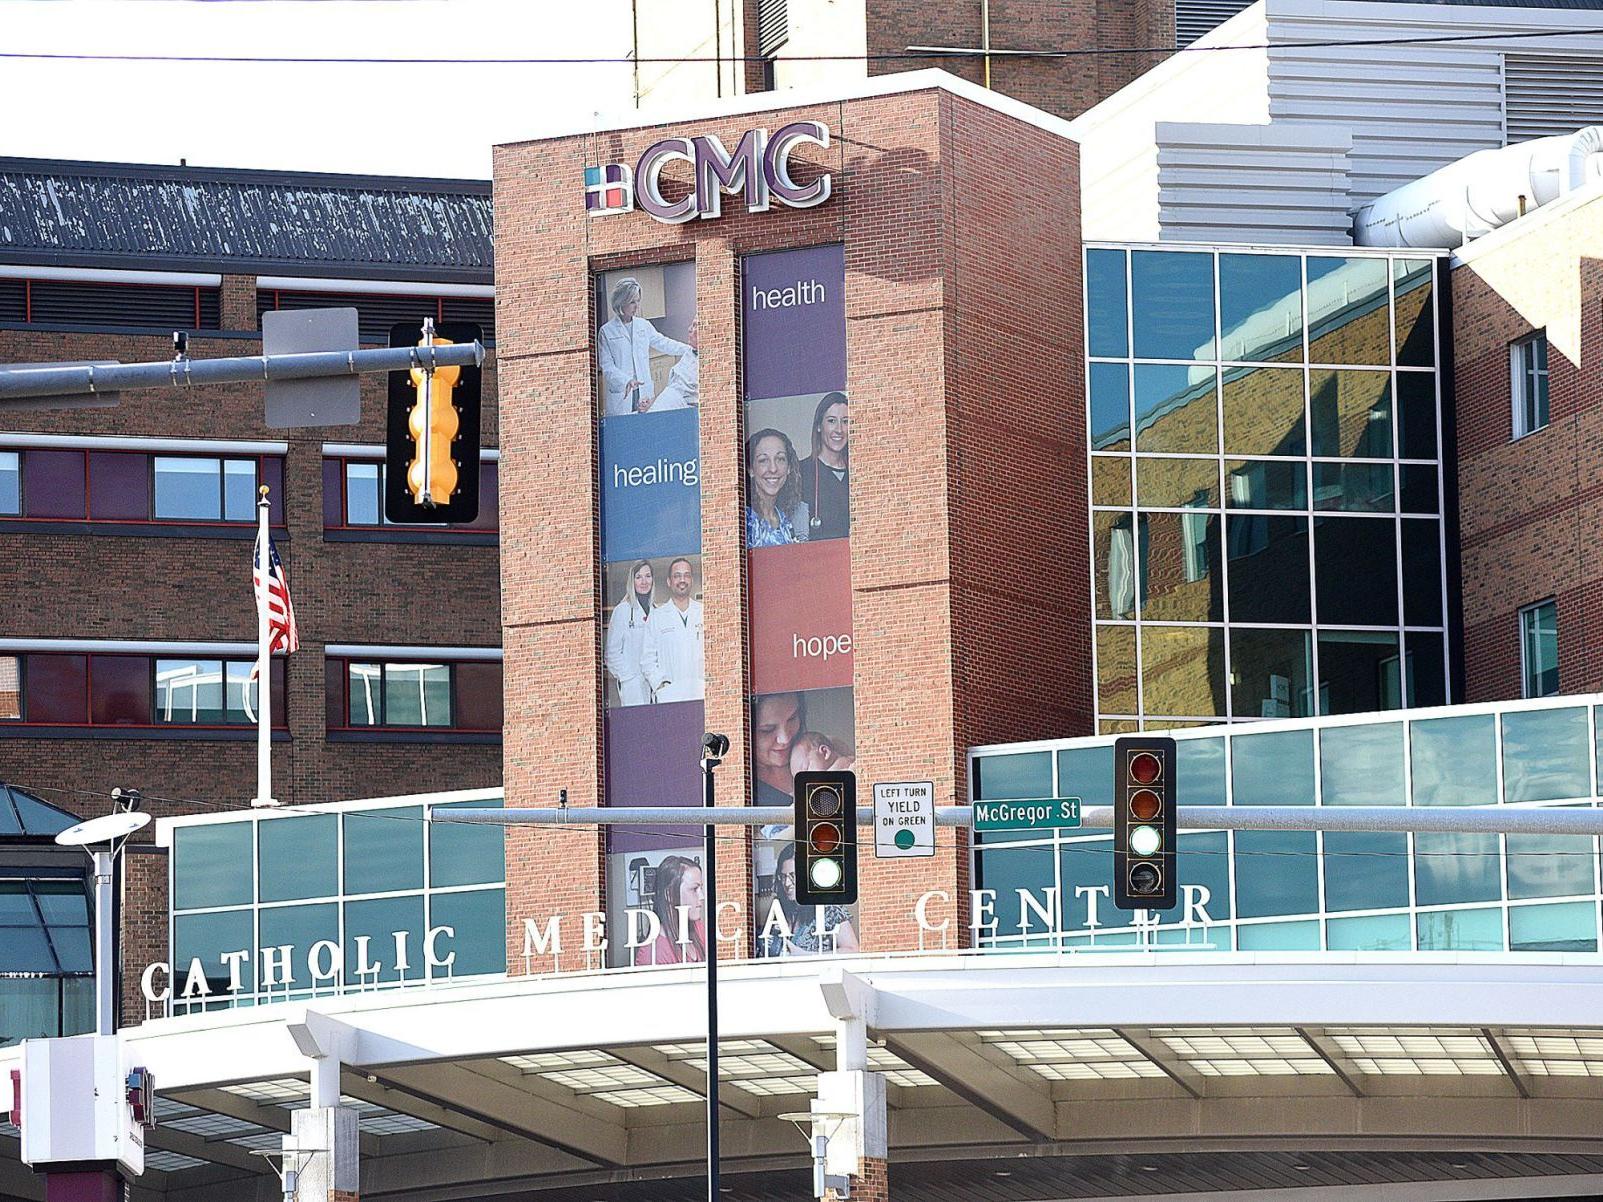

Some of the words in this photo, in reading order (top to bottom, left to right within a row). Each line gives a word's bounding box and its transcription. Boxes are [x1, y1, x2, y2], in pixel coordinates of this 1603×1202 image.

[634, 120, 832, 224] CMC
[752, 279, 825, 311] health
[613, 458, 699, 488] healing
[793, 633, 852, 661] hope
[880, 788, 901, 799] LEFT
[903, 787, 927, 798] TURN
[887, 800, 921, 813] YIELD
[882, 817, 897, 827] ON
[897, 816, 927, 826] GREEN
[976, 805, 1053, 826] McGregor
[1060, 801, 1078, 820] St
[141, 925, 456, 1003] CATHOLIC
[521, 898, 842, 956] MEDICAL
